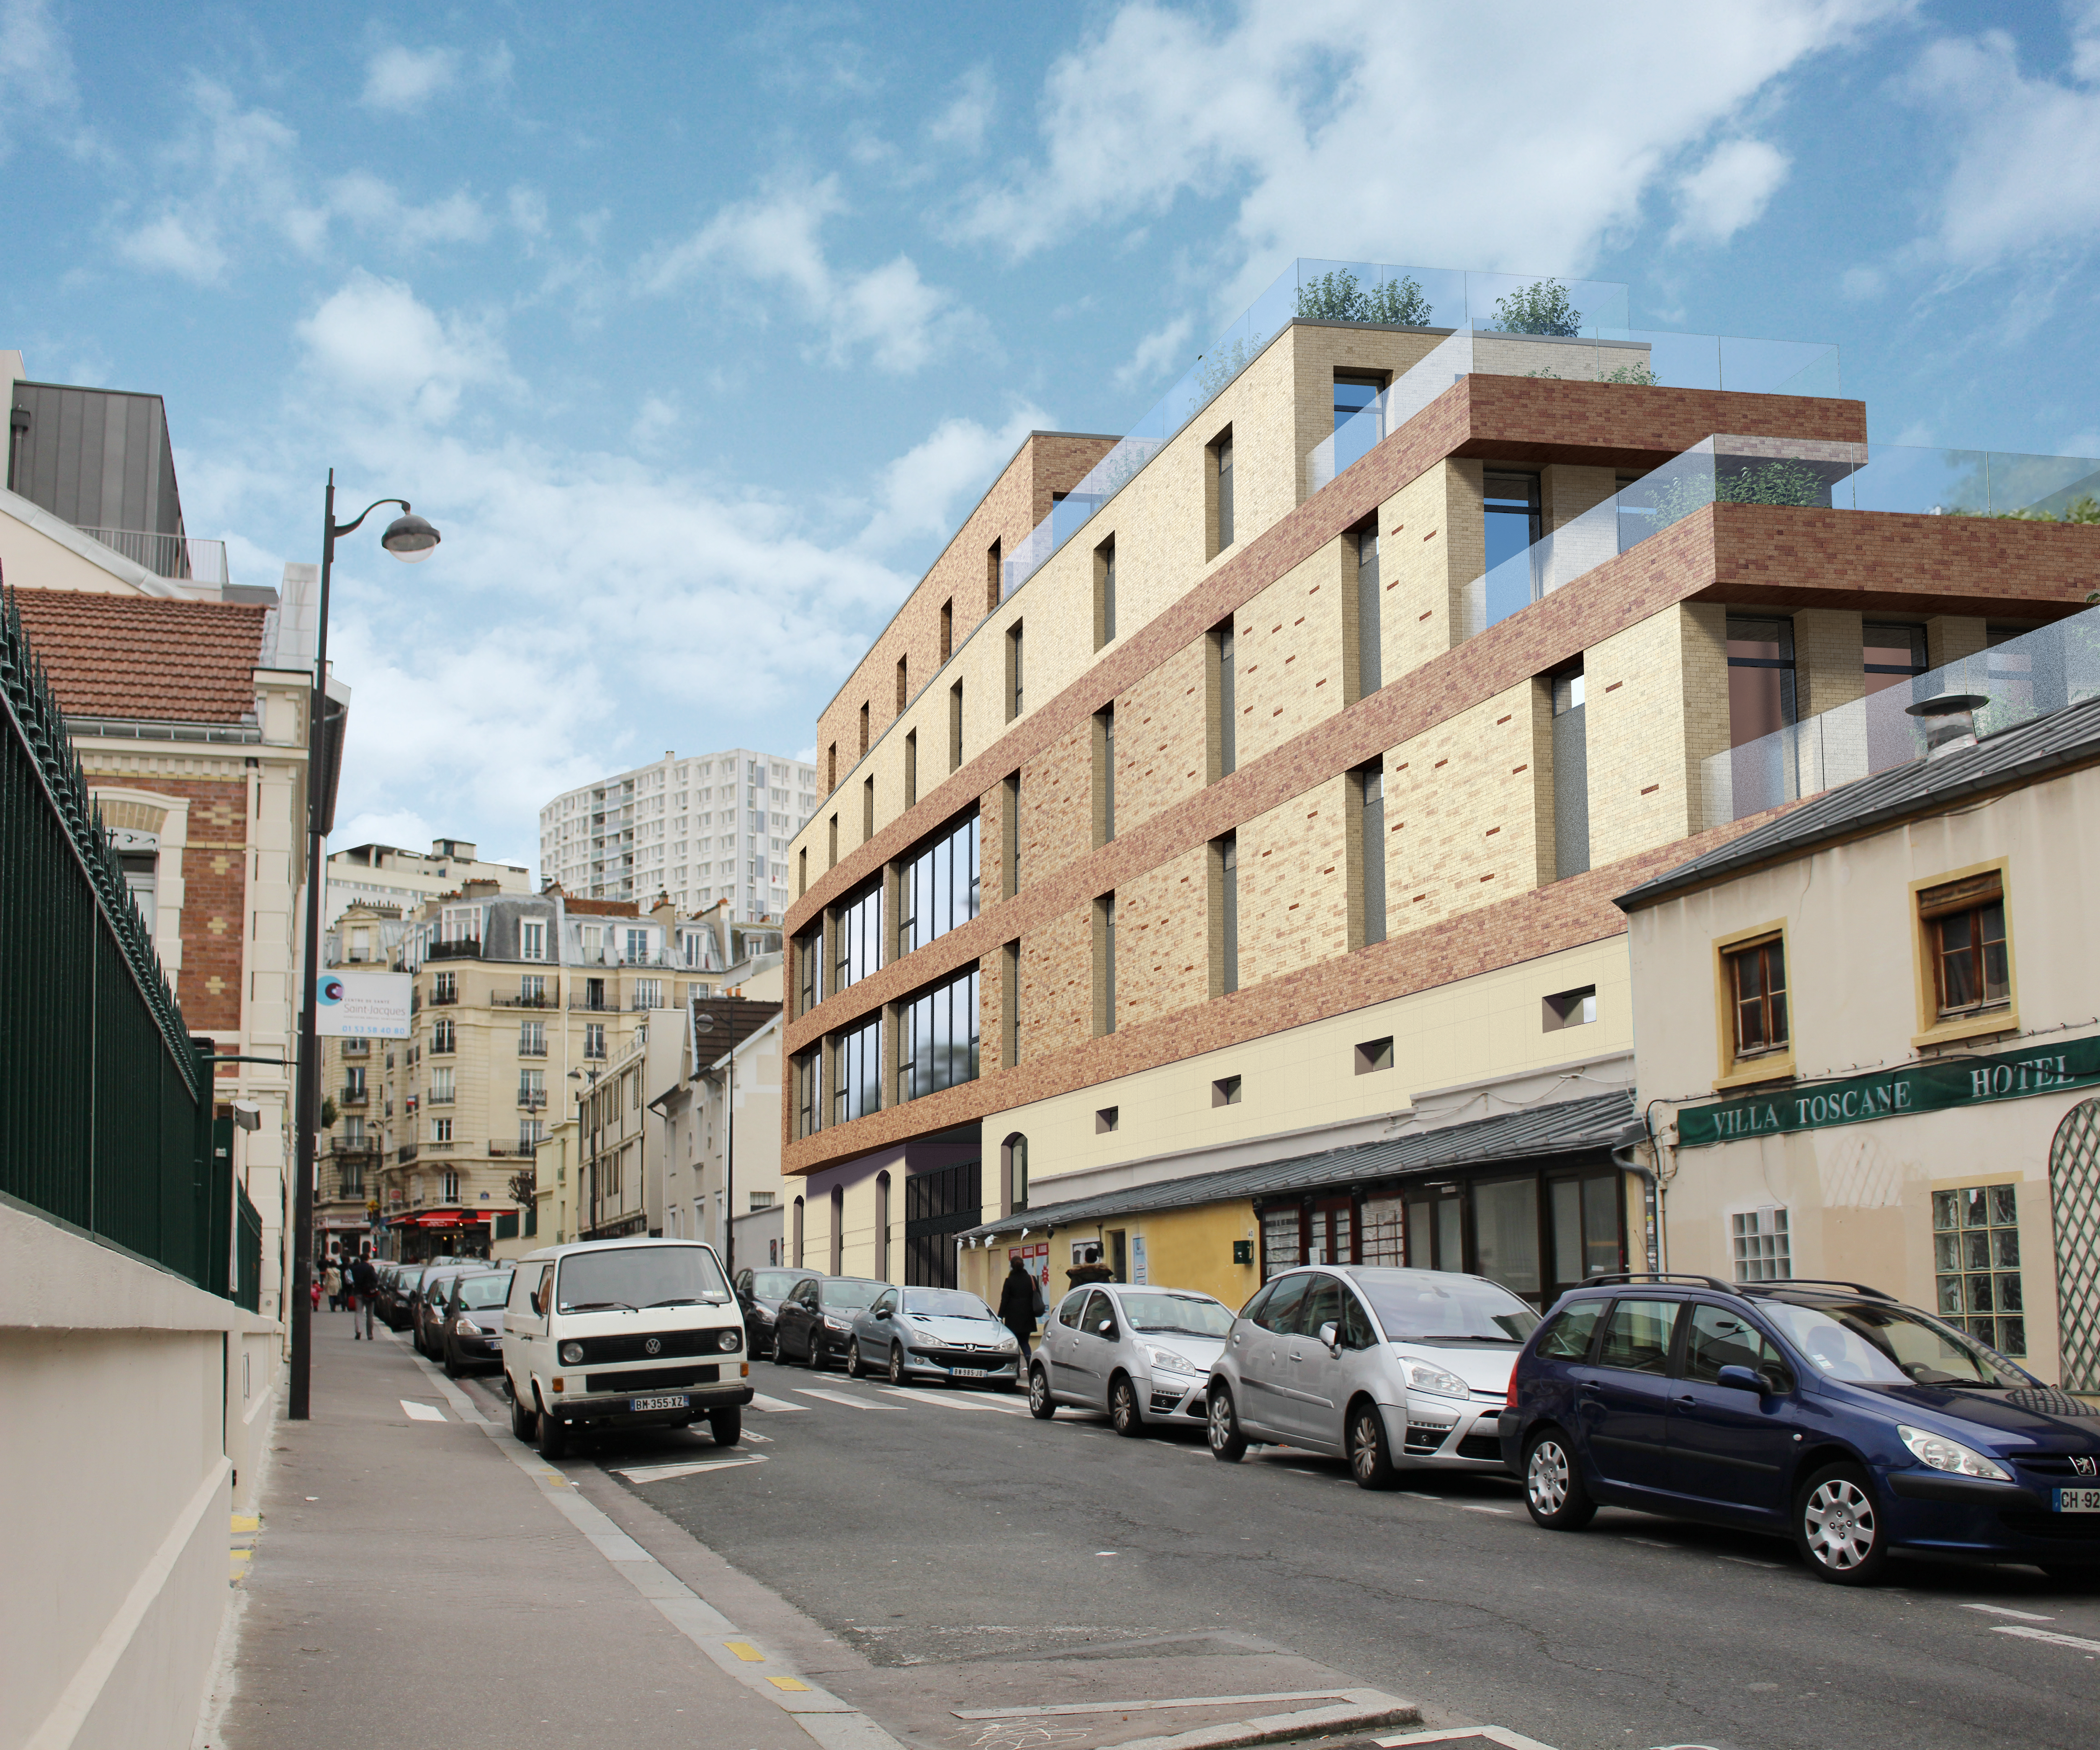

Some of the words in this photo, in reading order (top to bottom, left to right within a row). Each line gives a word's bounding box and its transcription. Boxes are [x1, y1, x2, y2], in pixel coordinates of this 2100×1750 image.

[1713, 1103, 1779, 1136] VILLA
[1796, 1082, 1912, 1124] TOSCANE
[1970, 1056, 2075, 1097] HOTEL
